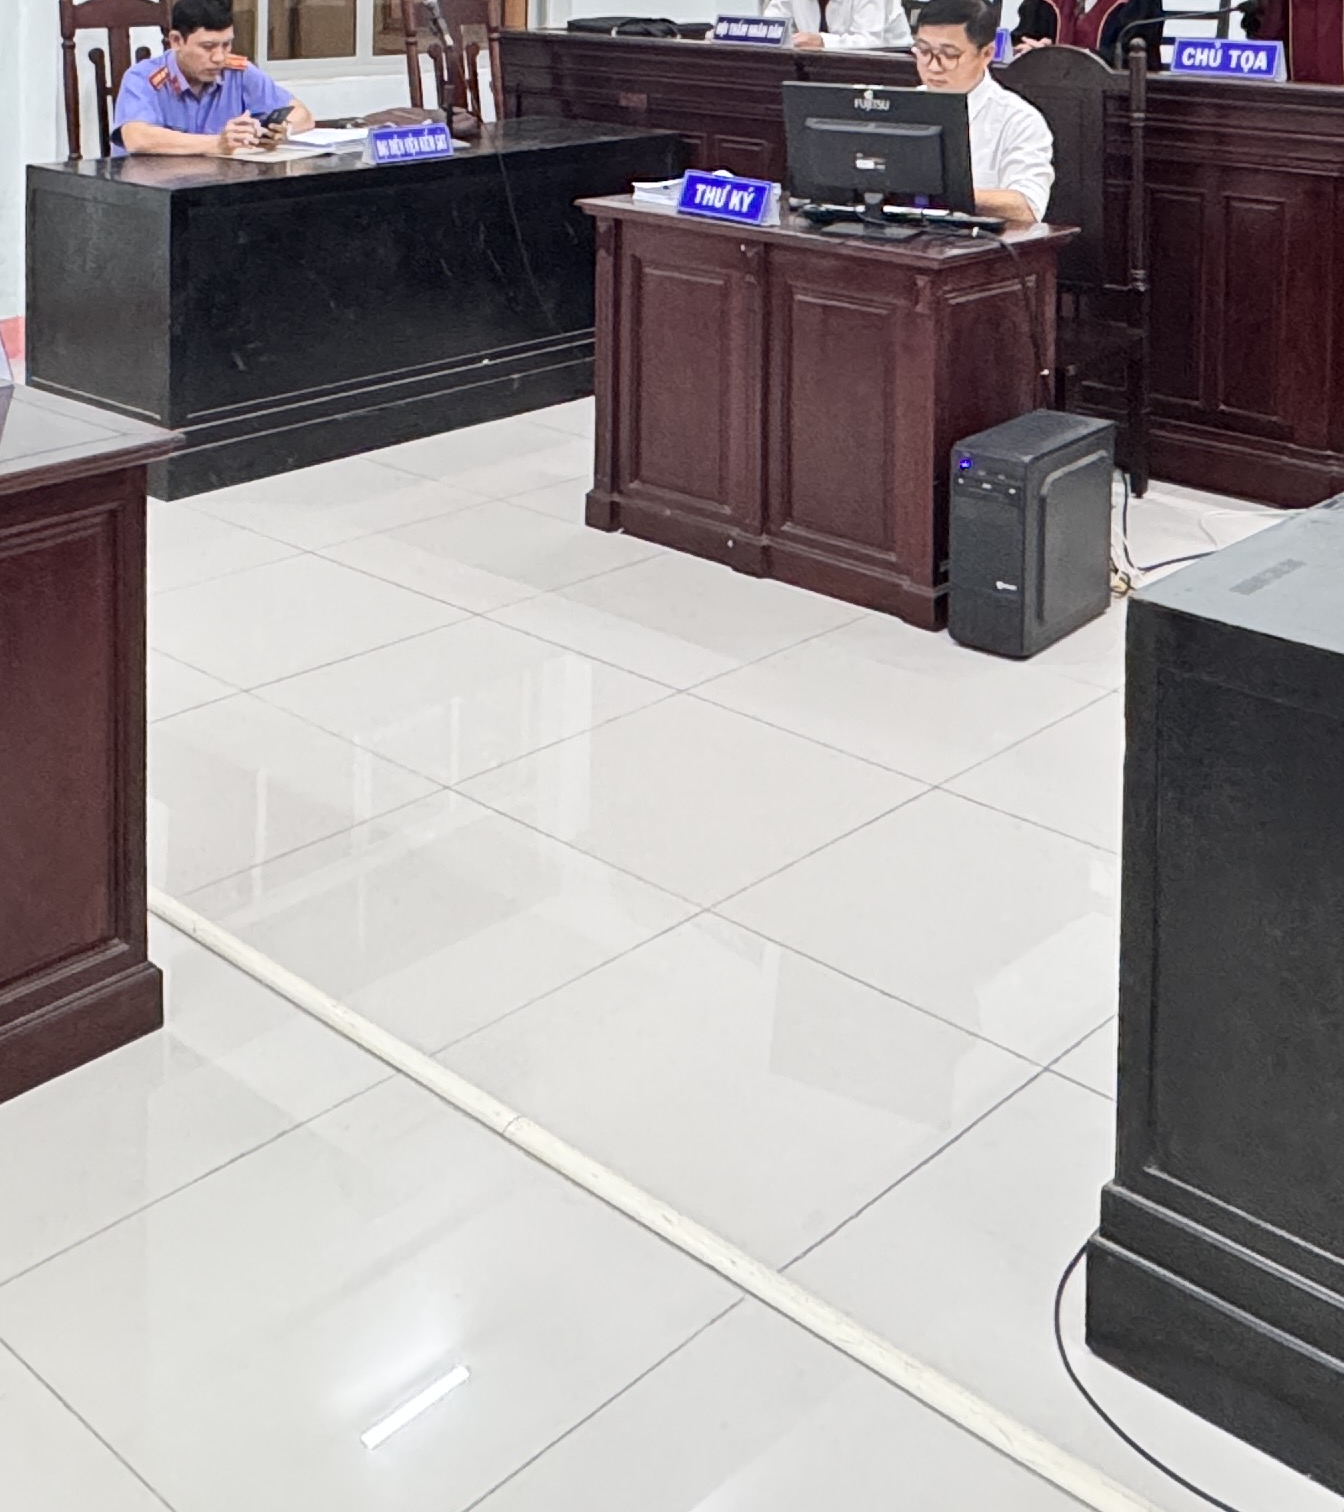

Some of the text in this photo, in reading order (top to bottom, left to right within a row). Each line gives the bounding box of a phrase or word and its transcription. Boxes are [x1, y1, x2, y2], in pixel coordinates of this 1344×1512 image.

[1182, 42, 1268, 74] CHỦ TỌA
[694, 183, 755, 213] THƯ KÝ
